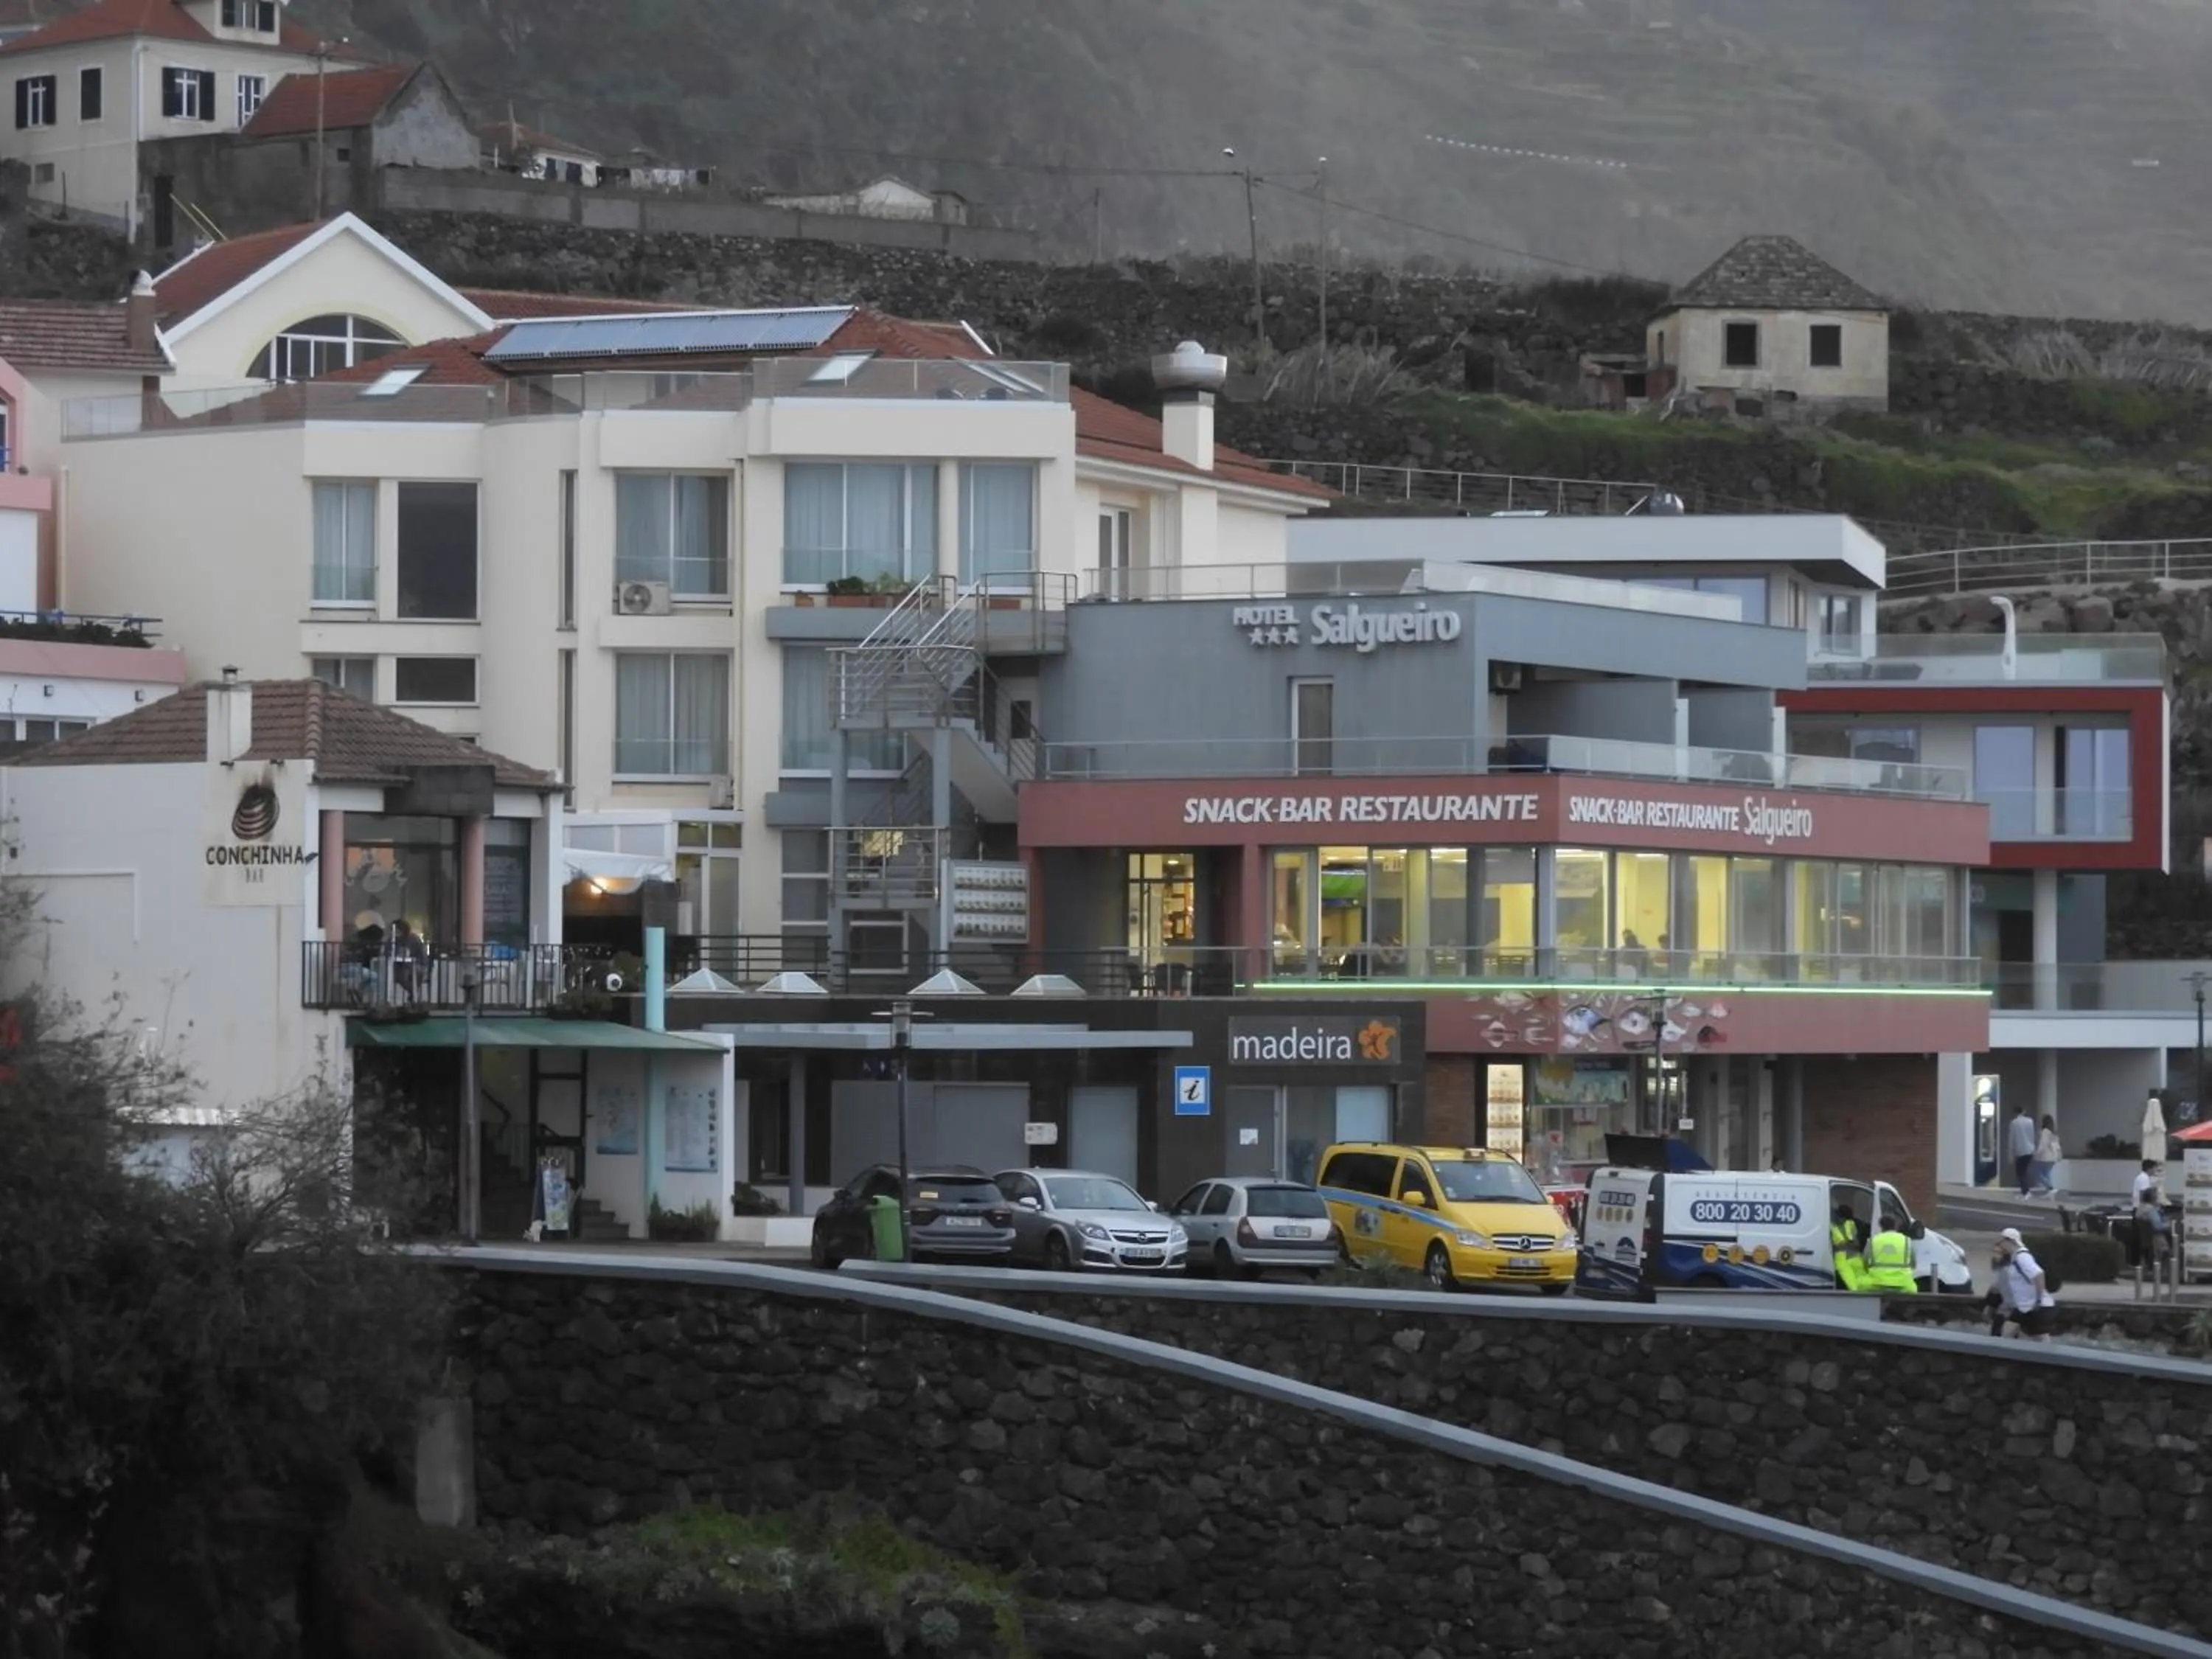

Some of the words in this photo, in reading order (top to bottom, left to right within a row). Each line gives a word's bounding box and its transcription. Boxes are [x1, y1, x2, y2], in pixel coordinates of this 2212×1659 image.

[1233, 605, 1300, 625] HOTEL
[1310, 602, 1461, 653] Salgueiro
[1183, 796, 1332, 824] SNACK-BAR
[1339, 794, 1539, 822] RESTAURANTE
[1569, 796, 1644, 825] SNACK-BAR
[1646, 801, 1739, 831] RESTAURANTE
[1743, 796, 1812, 845] Salgueiro
[206, 846, 305, 865] CONCHINHA
[1233, 1026, 1351, 1060] madeira
[1696, 1203, 1725, 1220] 800
[1731, 1203, 1750, 1221] 20
[1754, 1204, 1773, 1221] 30
[1776, 1205, 1796, 1222] 40
